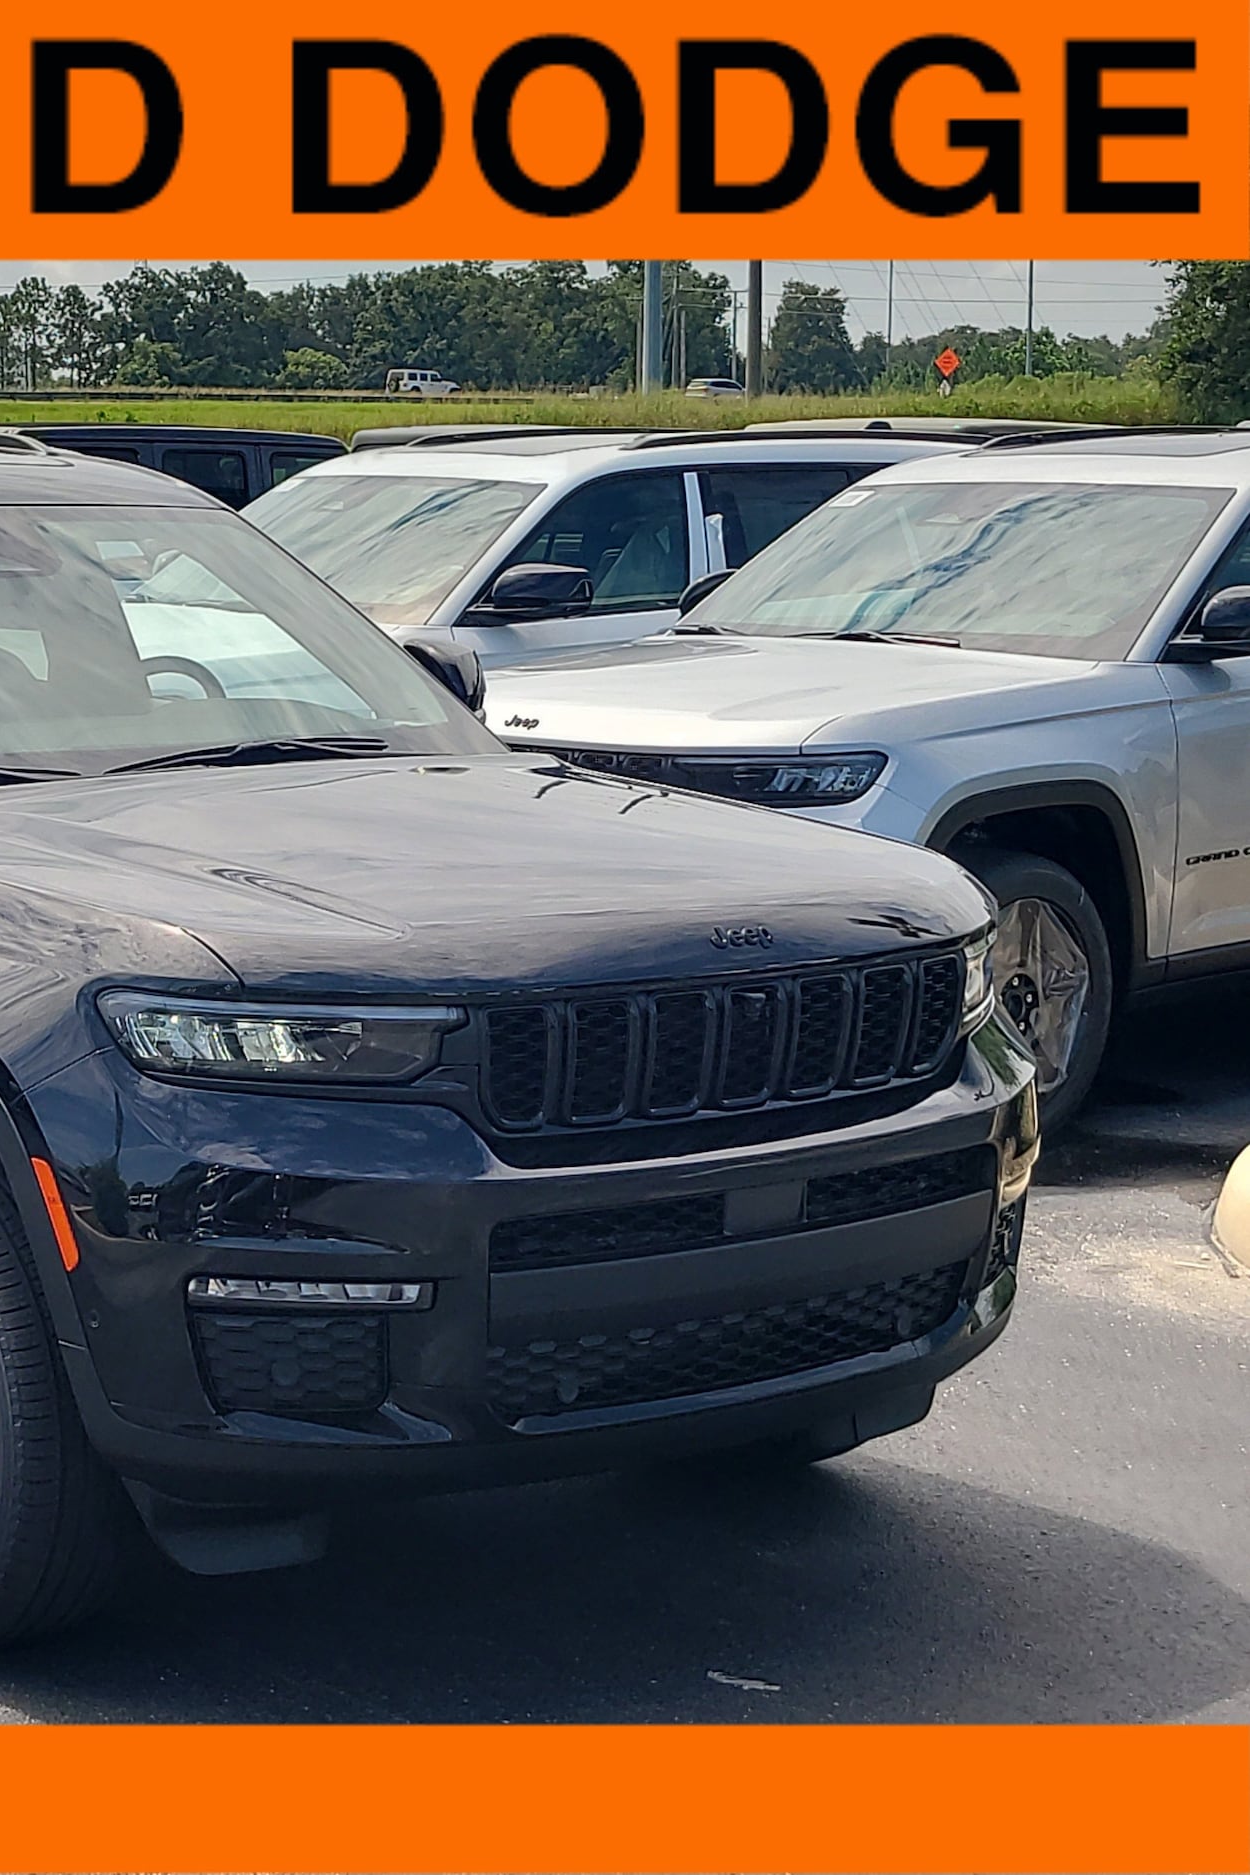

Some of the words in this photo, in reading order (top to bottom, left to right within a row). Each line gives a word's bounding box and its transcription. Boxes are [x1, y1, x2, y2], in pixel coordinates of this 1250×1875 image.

[504, 714, 540, 731] Jeep
[1186, 849, 1240, 866] GRAND
[710, 925, 774, 950] Jeep
